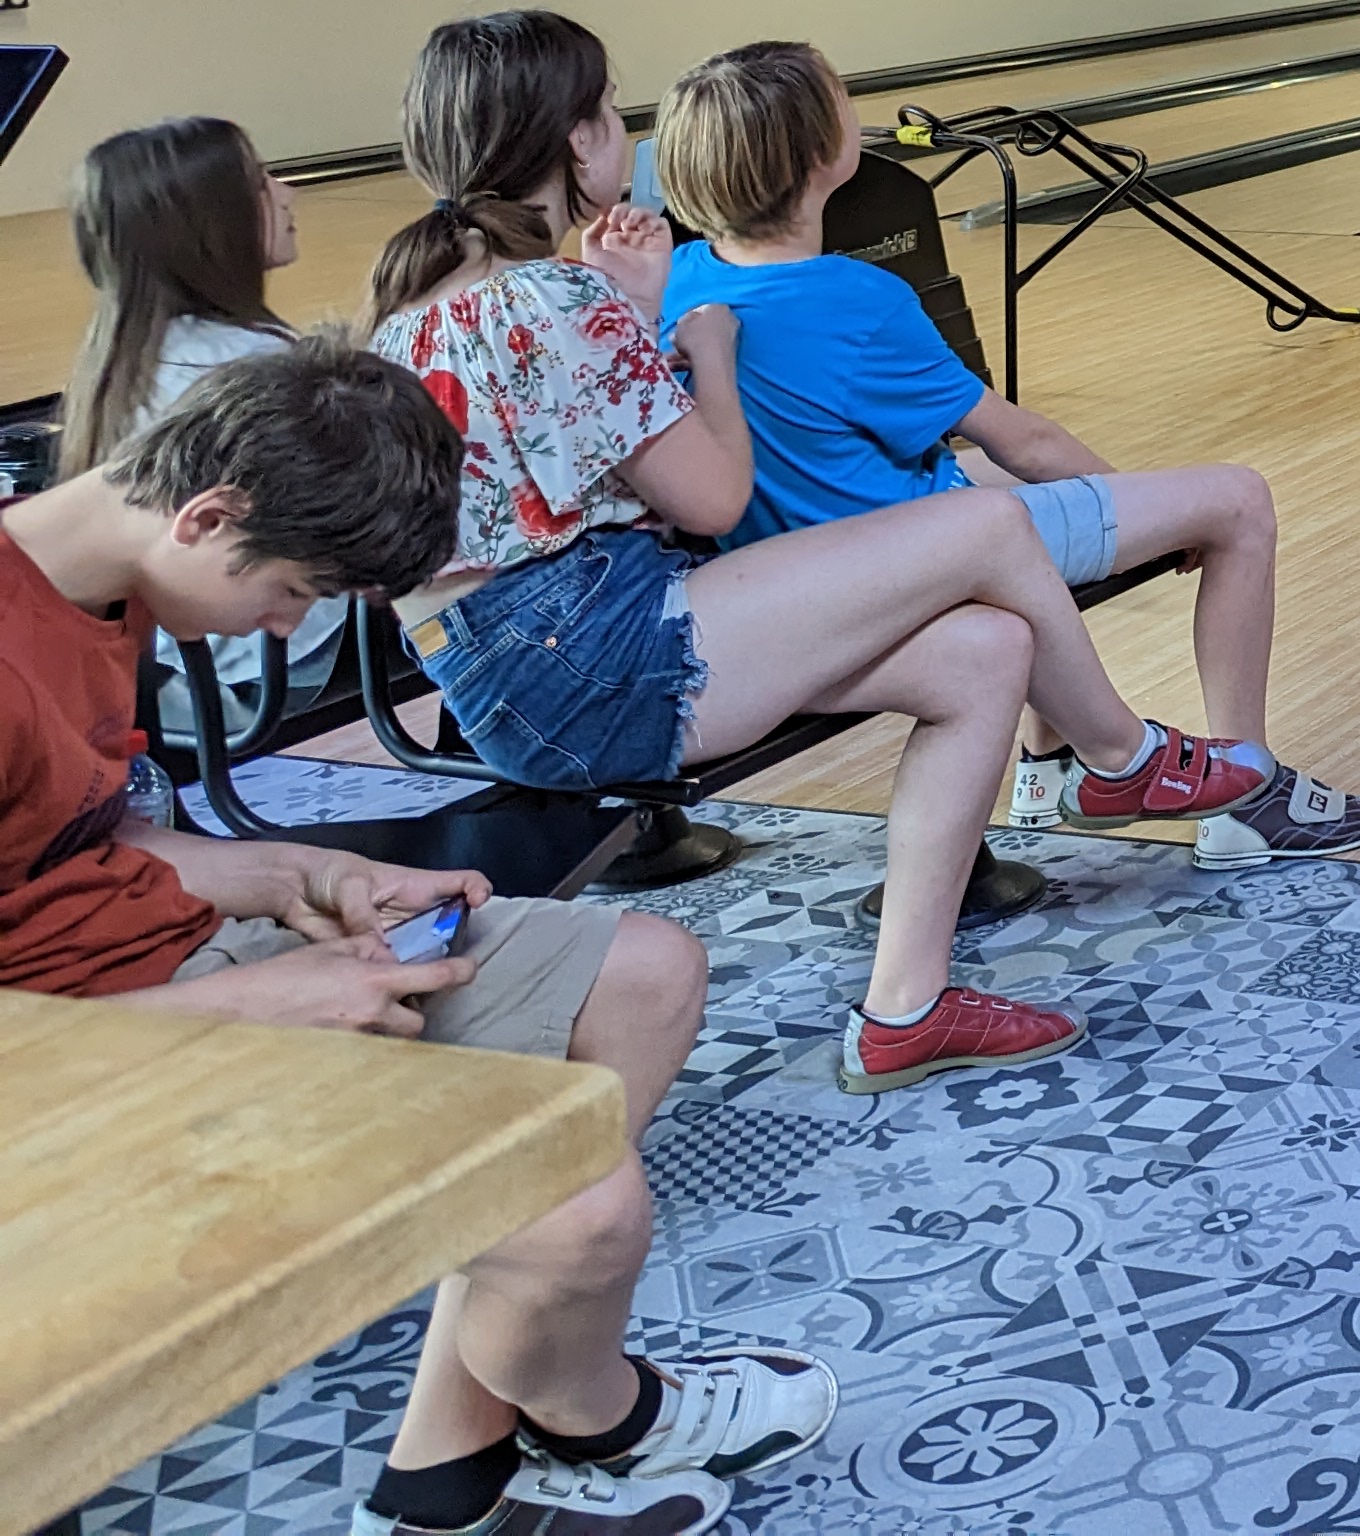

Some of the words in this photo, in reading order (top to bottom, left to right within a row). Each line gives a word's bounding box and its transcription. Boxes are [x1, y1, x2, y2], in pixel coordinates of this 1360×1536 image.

[1020, 774, 1038, 786] 42
[1017, 787, 1022, 799] 9
[1029, 787, 1045, 798] 10
